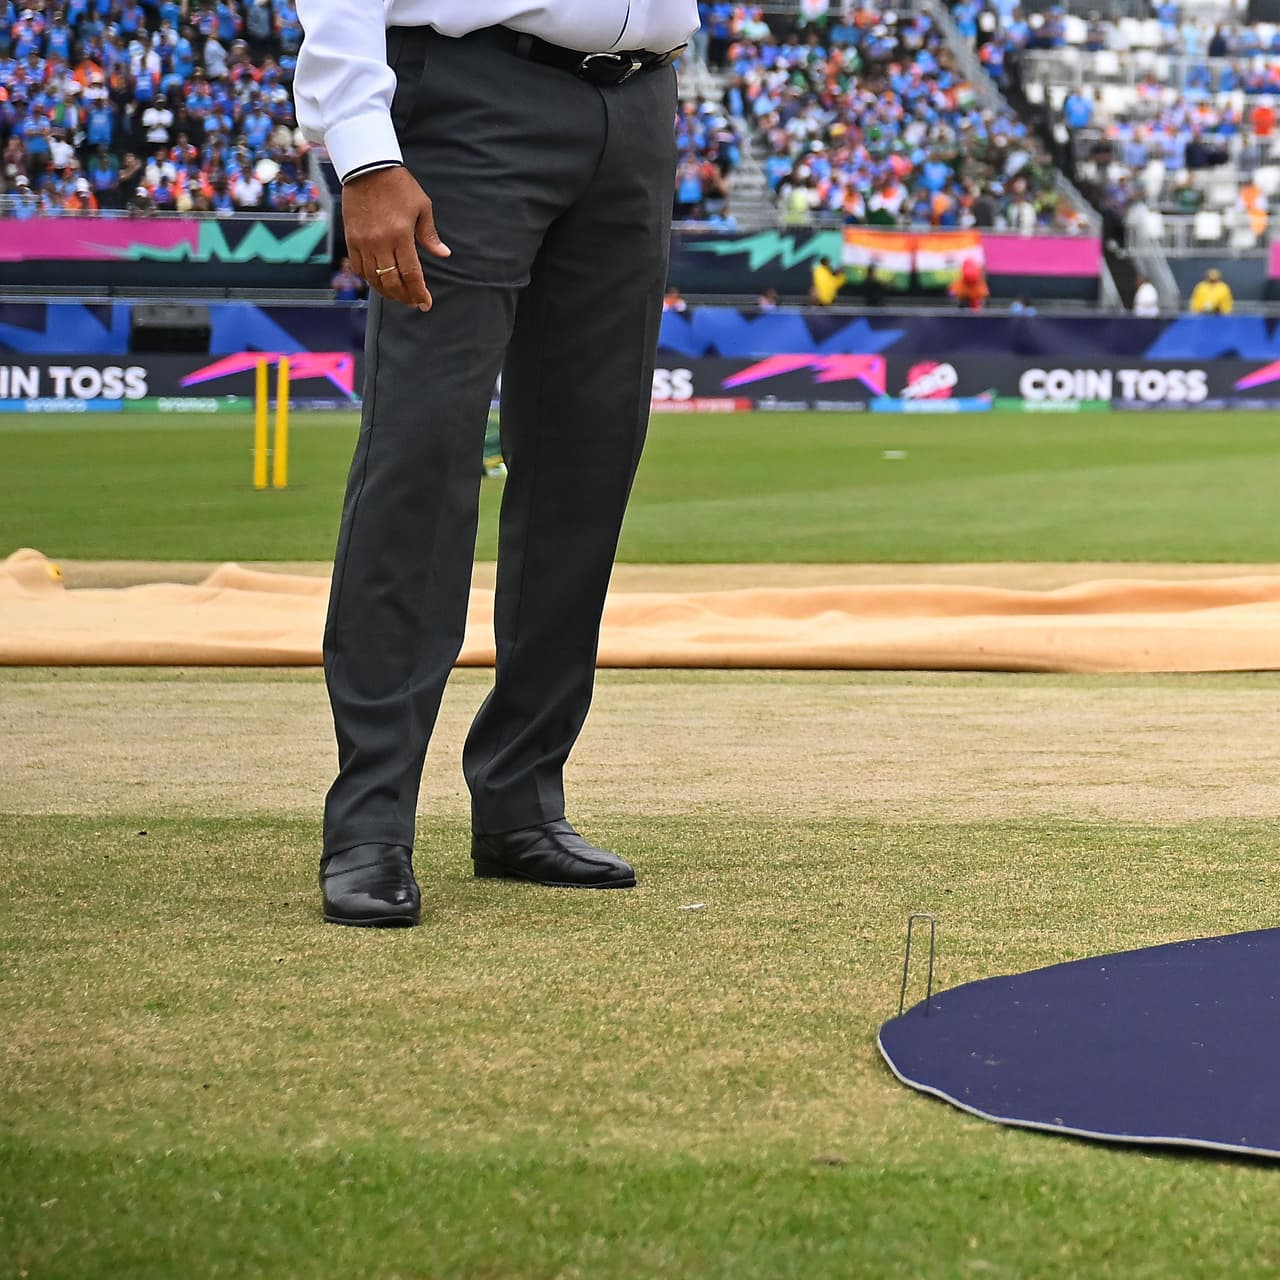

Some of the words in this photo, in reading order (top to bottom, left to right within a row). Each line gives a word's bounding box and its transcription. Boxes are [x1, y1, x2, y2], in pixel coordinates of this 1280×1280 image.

[48, 365, 149, 401] TOSS
[1019, 368, 1113, 401] COIN
[1117, 369, 1209, 402] TOSS
